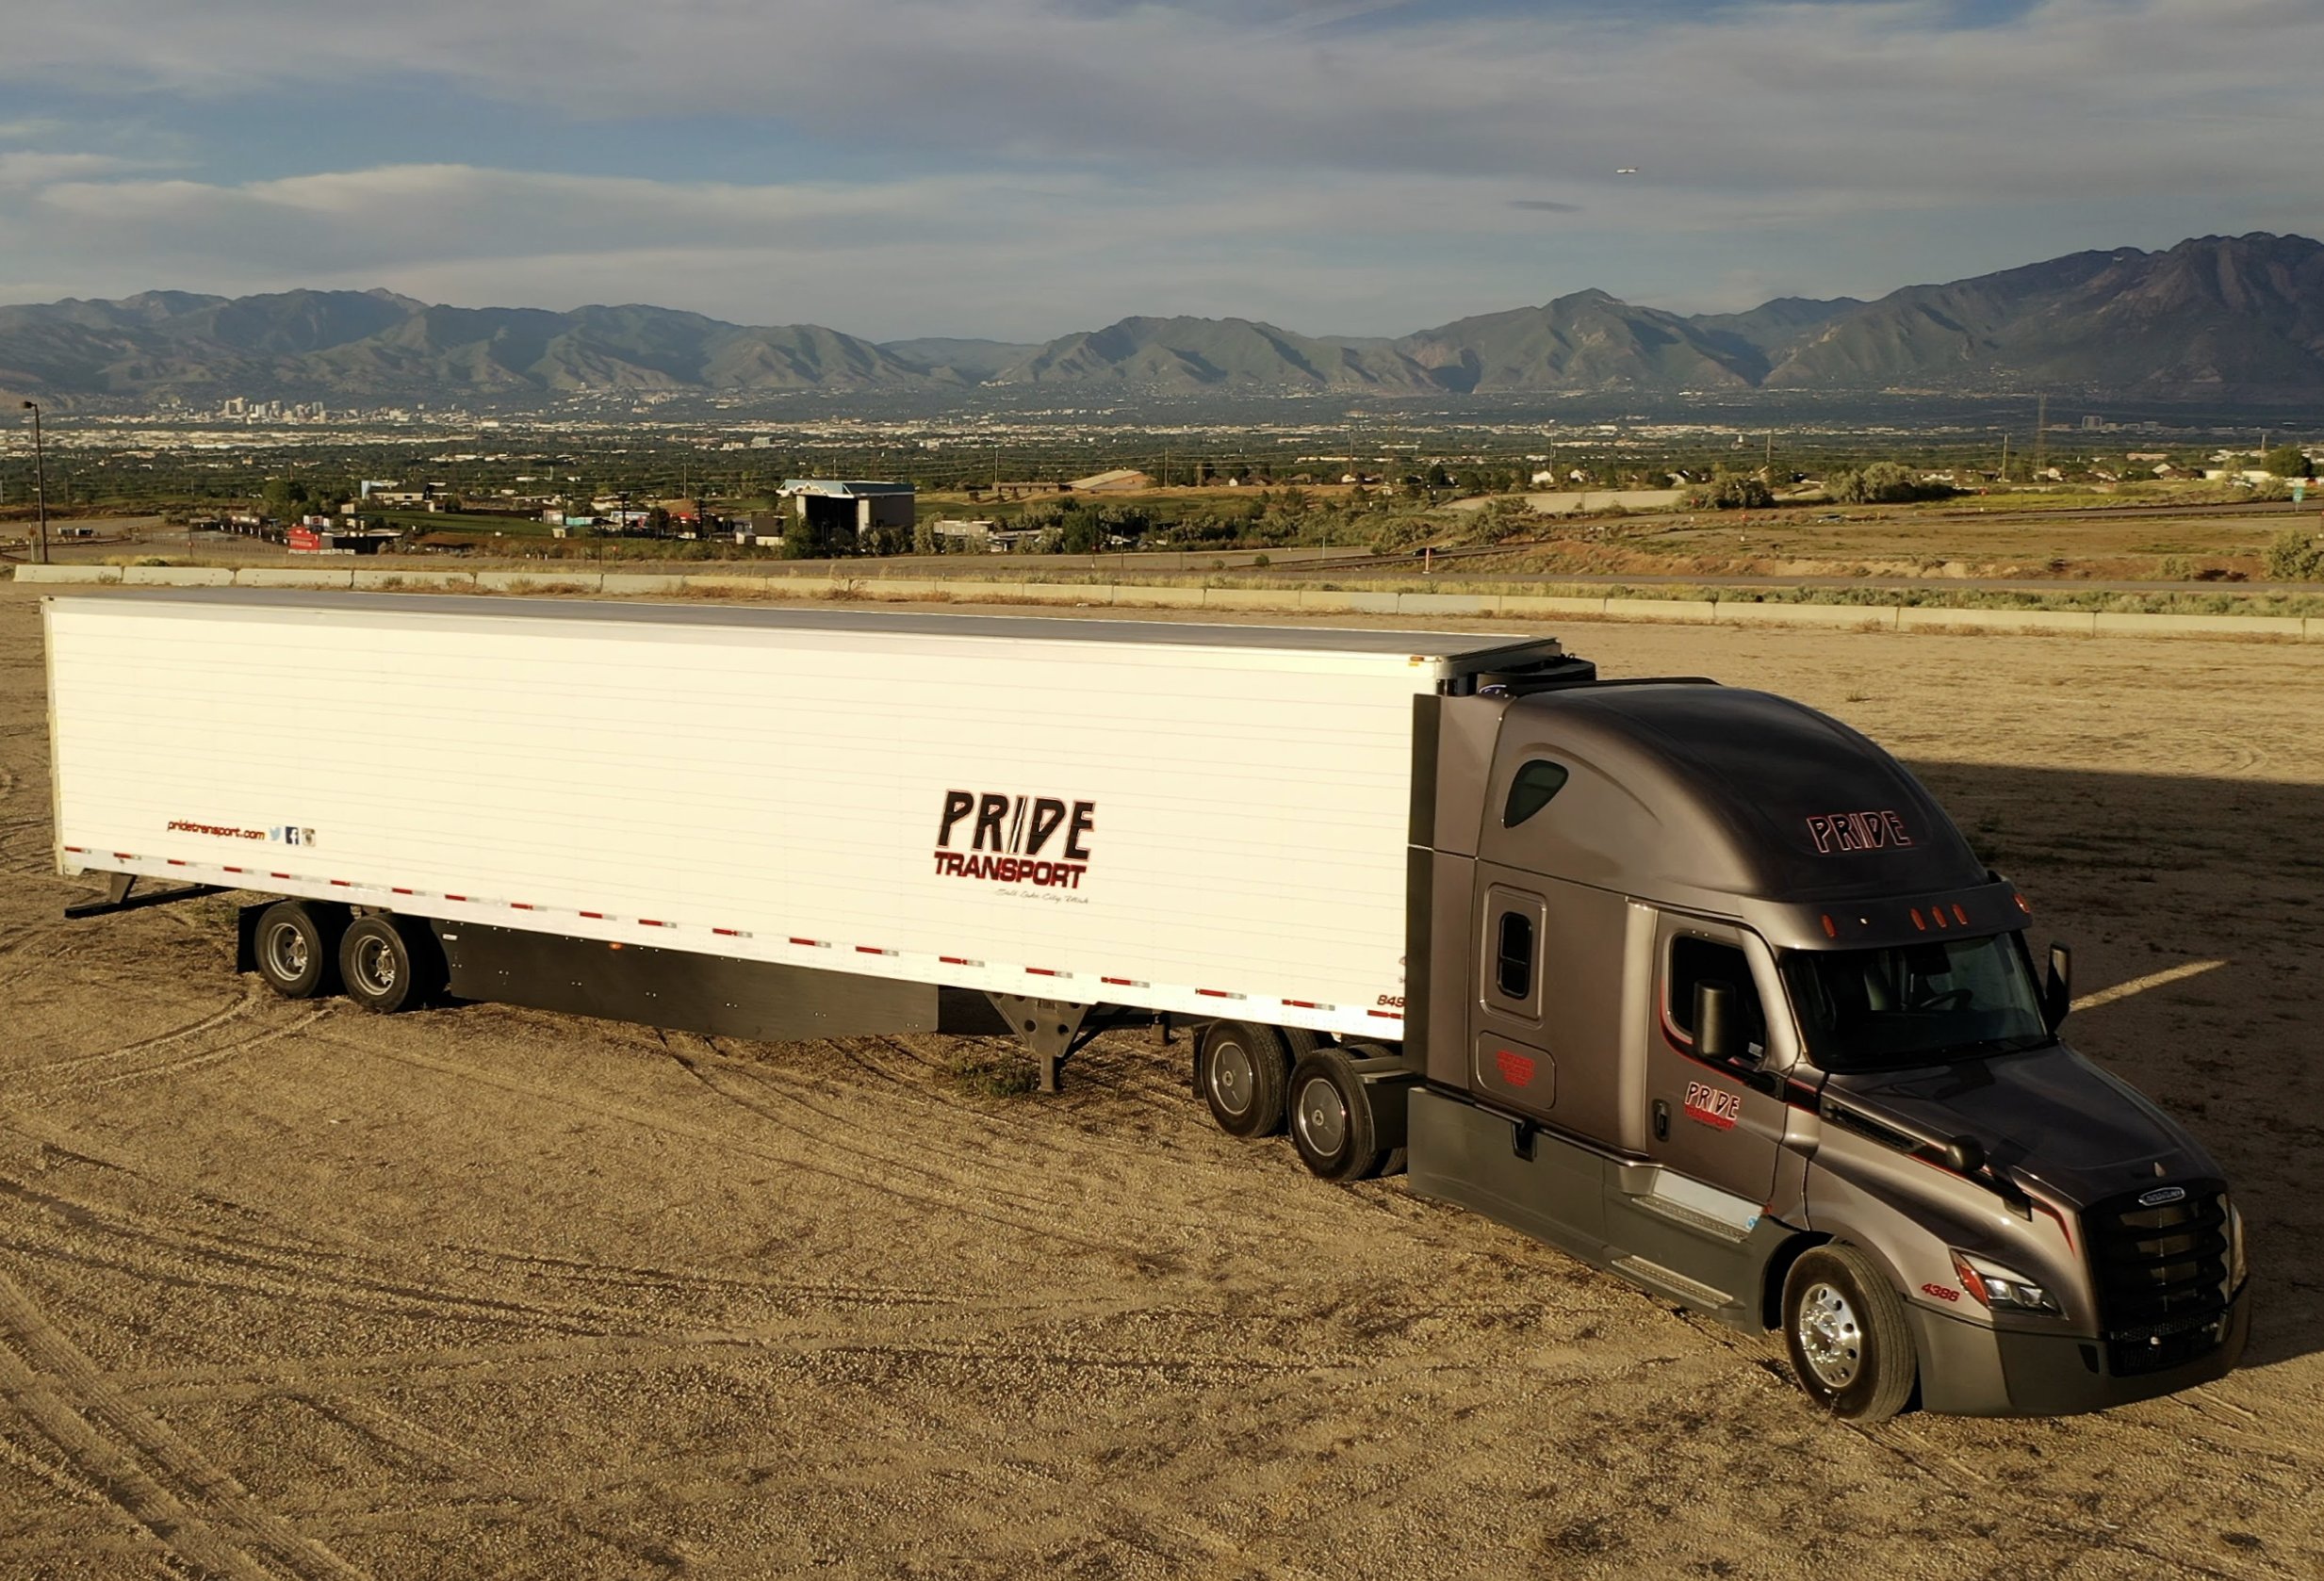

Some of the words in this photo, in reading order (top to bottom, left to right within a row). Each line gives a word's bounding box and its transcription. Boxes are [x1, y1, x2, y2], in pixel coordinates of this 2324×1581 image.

[167, 820, 265, 840] pridetransport.com
[937, 790, 1095, 861] PRIDE
[1806, 810, 1912, 854] PRIDE
[934, 851, 1087, 888] TRANSPORT
[1685, 1082, 1740, 1120] PRIDE
